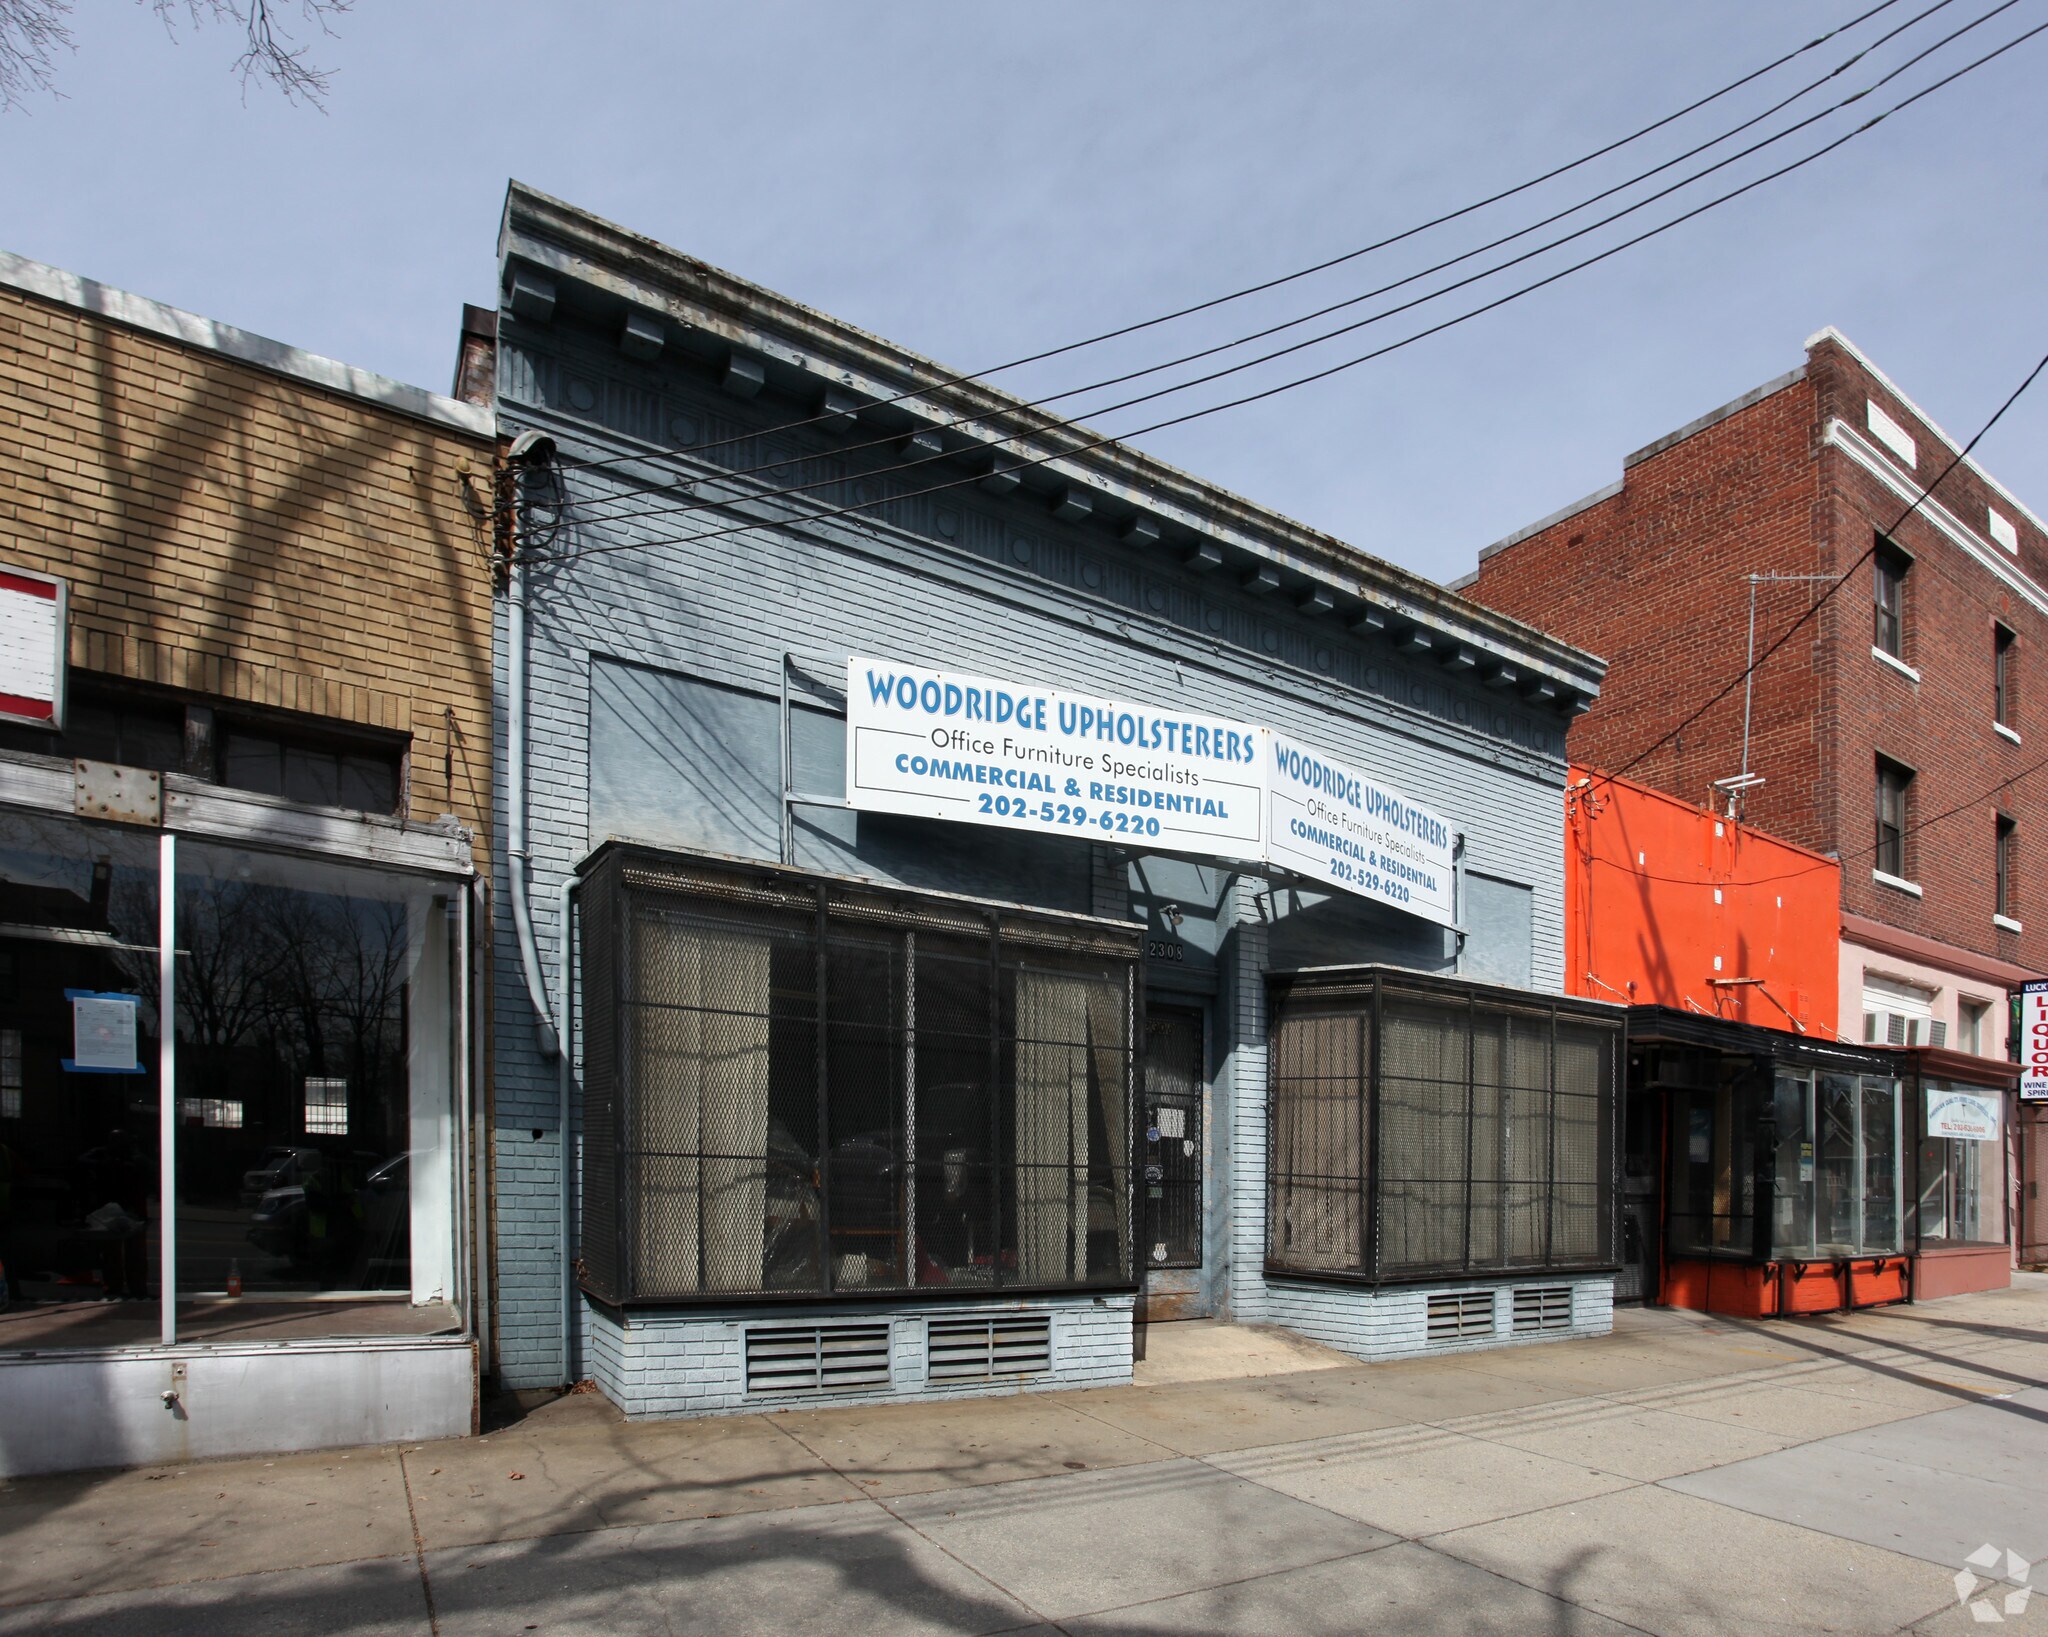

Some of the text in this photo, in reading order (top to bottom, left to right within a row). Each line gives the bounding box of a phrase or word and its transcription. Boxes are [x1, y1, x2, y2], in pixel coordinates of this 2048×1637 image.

[866, 668, 1254, 765] WOODRIDGE UPHOLSTERERS
[895, 753, 1229, 819] COMMERCIAL & RESIDENTIAL
[931, 727, 1200, 786] Office Furniture Specialists
[978, 793, 1160, 837] 202-529-6220
[1275, 741, 1448, 850] WOODRIDGE UPHOLSTERERS
[1290, 818, 1438, 892] COMMERCIAL & RESIDENTIAL
[1307, 798, 1426, 865] Office Furniture Specialists
[1330, 857, 1410, 903] 202-529-6220
[1150, 942, 1183, 960] 2308
[2025, 983, 2048, 992] LUCK
[2024, 1081, 2047, 1089] WINE
